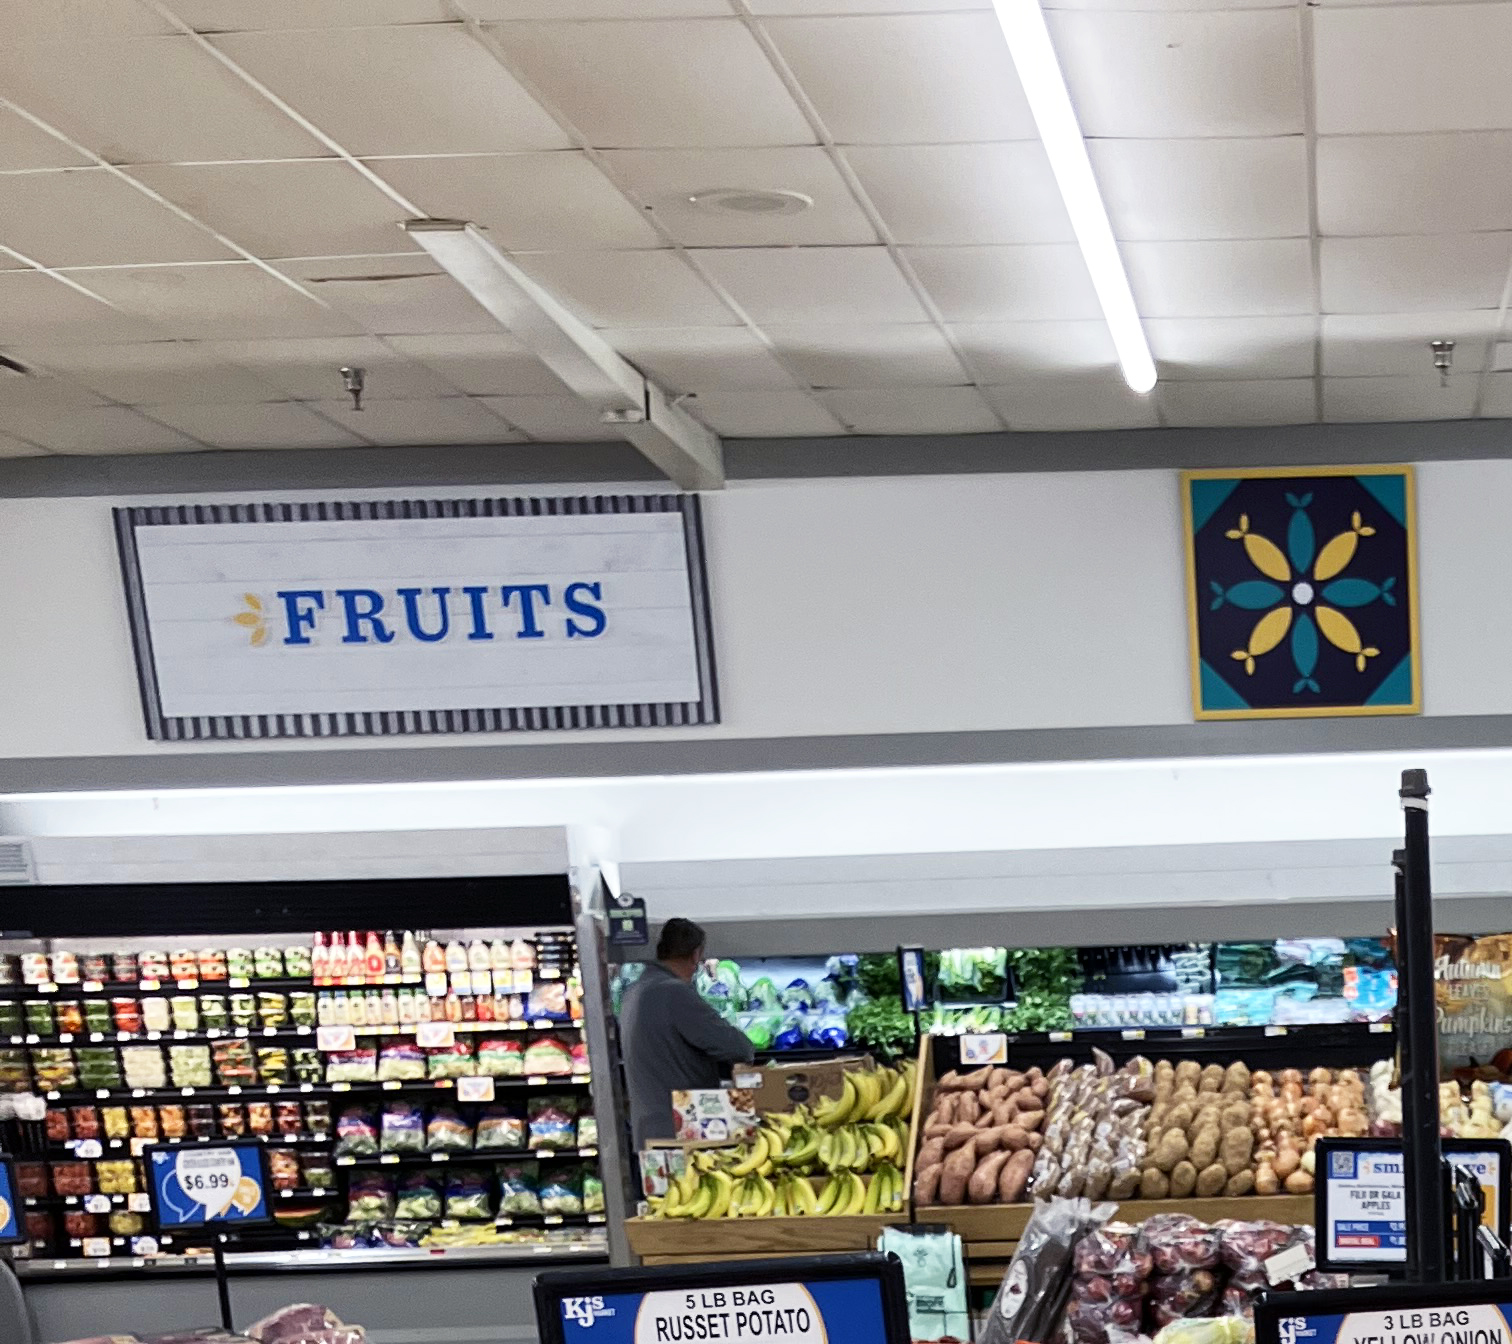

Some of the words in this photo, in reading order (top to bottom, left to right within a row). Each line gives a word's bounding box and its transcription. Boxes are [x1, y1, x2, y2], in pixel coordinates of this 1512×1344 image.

[277, 580, 609, 645] FRUITS
[1360, 1201, 1391, 1211] APPLES
[686, 1295, 695, 1309] 5
[700, 1292, 727, 1308] LB
[732, 1289, 775, 1307] BAG
[655, 1312, 730, 1342] RUSSET
[736, 1307, 811, 1337] POTATO
[1383, 1315, 1393, 1330] 3
[1399, 1312, 1425, 1329] LB
[1429, 1310, 1470, 1327] BAG
